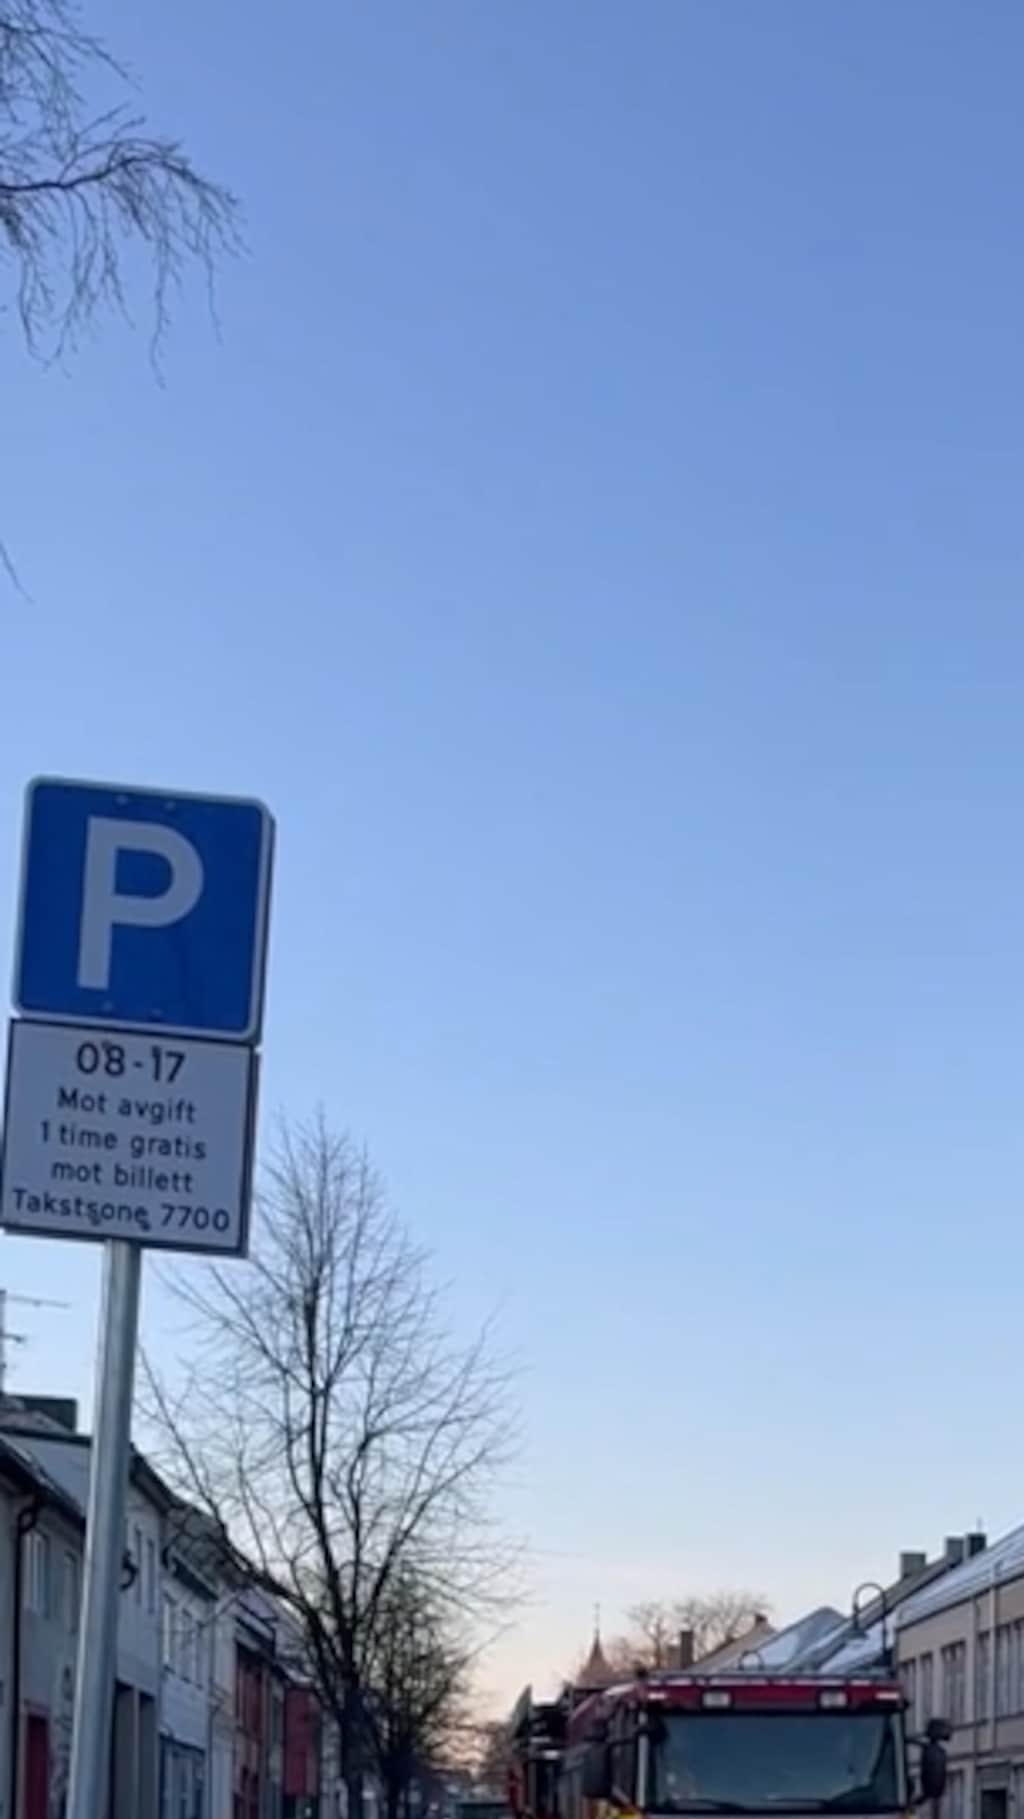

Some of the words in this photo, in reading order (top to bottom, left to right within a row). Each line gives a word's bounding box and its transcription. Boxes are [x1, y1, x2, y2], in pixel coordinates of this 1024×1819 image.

[76, 814, 205, 991] P
[57, 1086, 107, 1115] Mot
[118, 1097, 197, 1126] avgift
[40, 1121, 49, 1143] 1
[58, 1123, 118, 1150] time
[130, 1135, 208, 1160] gratis
[51, 1161, 103, 1184] mot
[113, 1163, 194, 1194] billett
[12, 1188, 149, 1226] Takstsone
[160, 1203, 231, 1233] 7700
